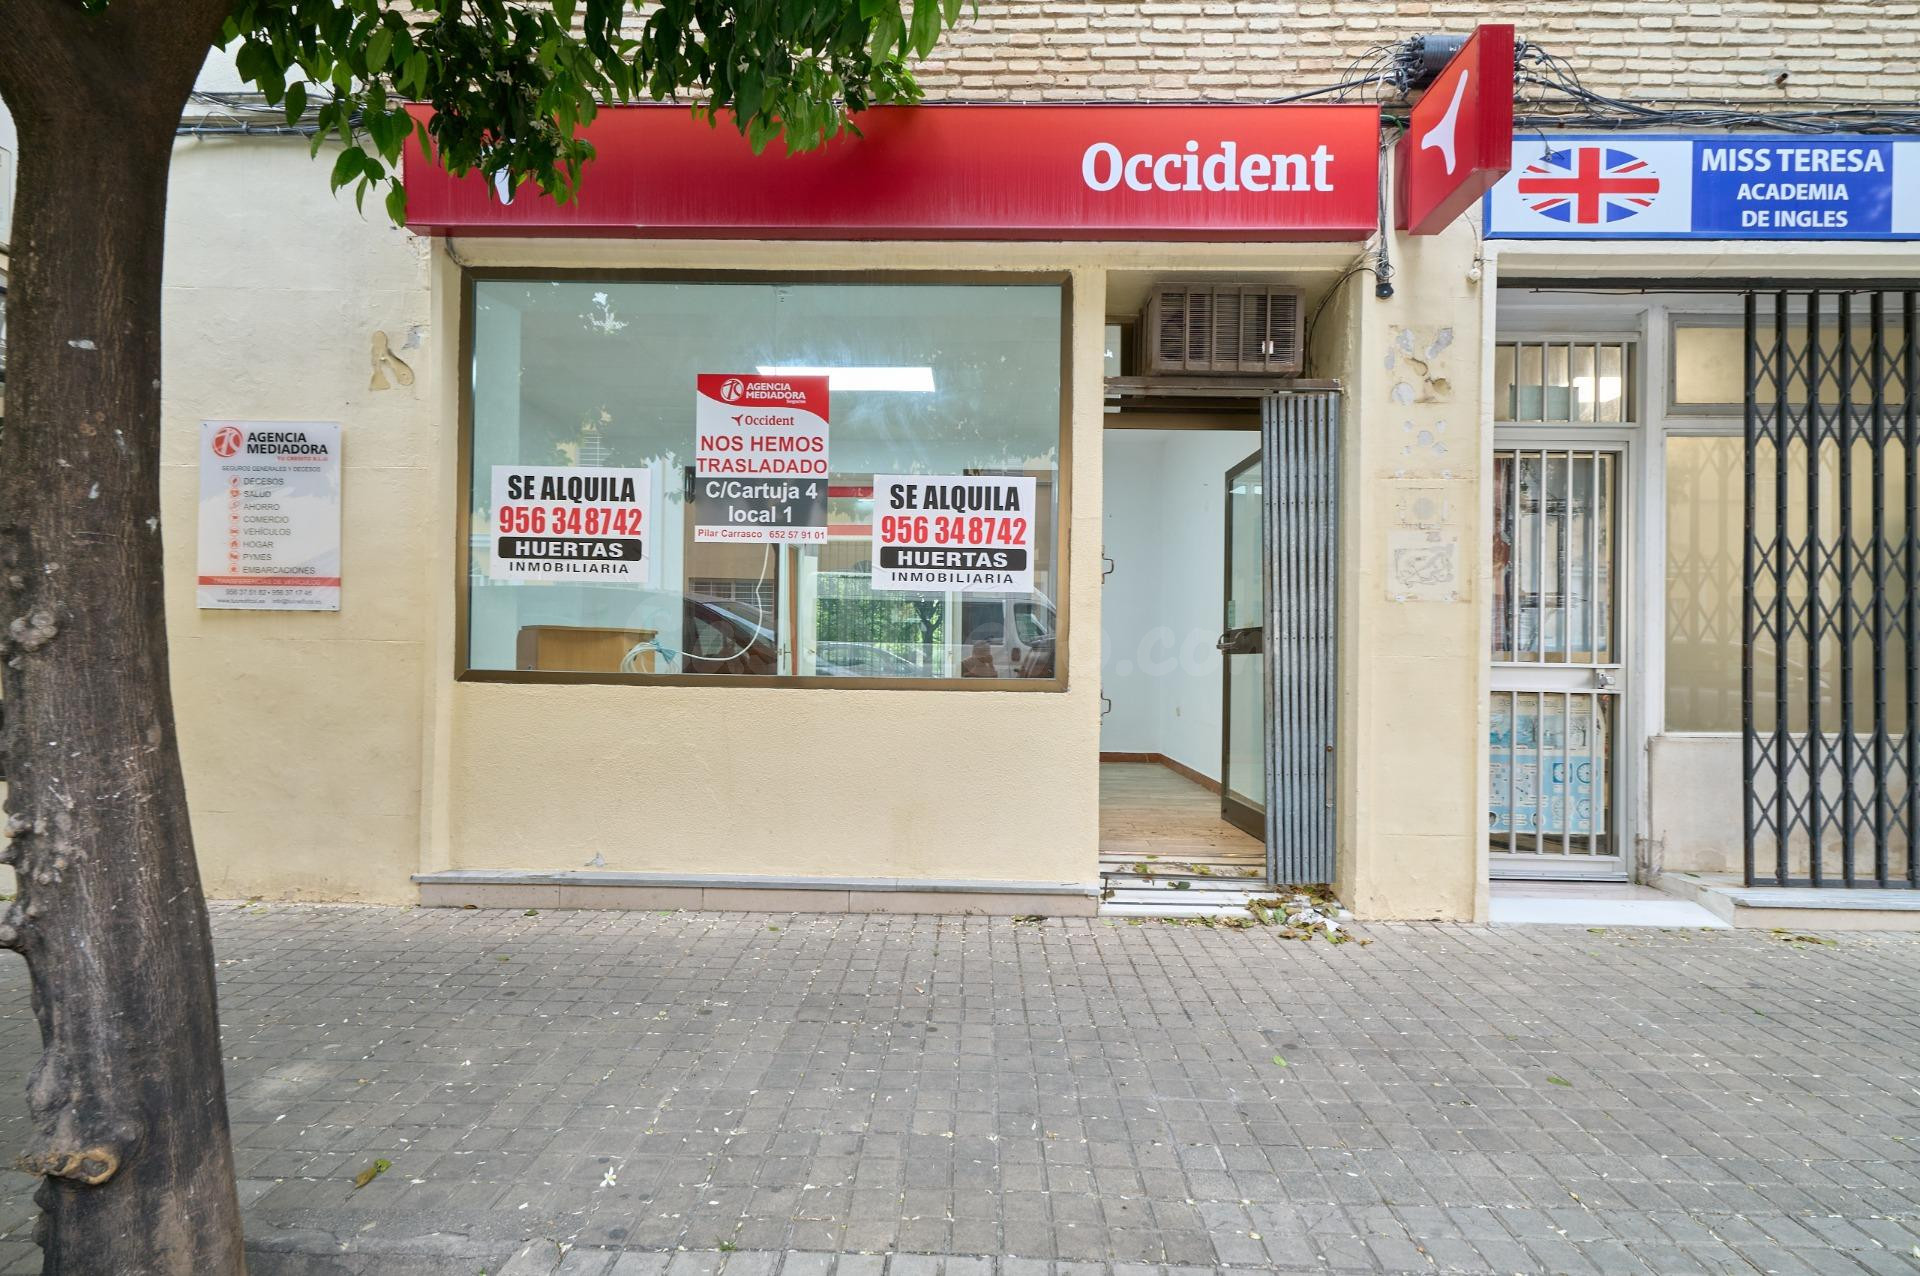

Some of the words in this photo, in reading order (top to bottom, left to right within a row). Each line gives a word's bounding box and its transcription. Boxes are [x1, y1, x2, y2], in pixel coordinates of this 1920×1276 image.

[1082, 140, 1335, 192] Occident
[1702, 148, 1771, 172] MISS
[1775, 148, 1885, 173] TERESA
[1737, 183, 1849, 201] ACADEMIA
[1742, 210, 1769, 228] DE
[1774, 210, 1848, 228] INGLES
[746, 382, 792, 391] AGENCIA
[745, 391, 806, 400] MEDIADORA
[745, 415, 795, 426] Occident
[247, 432, 307, 443] AGENCIA
[701, 435, 744, 451] NOS
[751, 436, 824, 452] HEMOS
[246, 444, 329, 455] MEDIADORA
[696, 457, 828, 474] TRASLADADO
[243, 478, 284, 486] DECESOS
[508, 475, 535, 500] SE
[540, 476, 636, 503] ALQUILA
[705, 481, 800, 503] C/Cartuja
[805, 482, 818, 499] 4
[890, 484, 918, 510] SE
[923, 485, 1020, 513] ALQUILA
[500, 506, 546, 533] 956
[728, 506, 776, 523] local
[783, 506, 792, 522] 1
[698, 529, 718, 537] Pilar
[721, 529, 763, 538] Carrasco
[769, 530, 785, 538] 652
[788, 530, 799, 538] 57
[801, 531, 811, 539] 91
[814, 531, 825, 539] 01
[881, 516, 929, 543] 956
[515, 541, 624, 558] HUERTAS
[509, 562, 629, 573] INMOBILIARIA
[897, 551, 1008, 568] HUERTAS
[892, 572, 1014, 584] INMOBILIARIA
